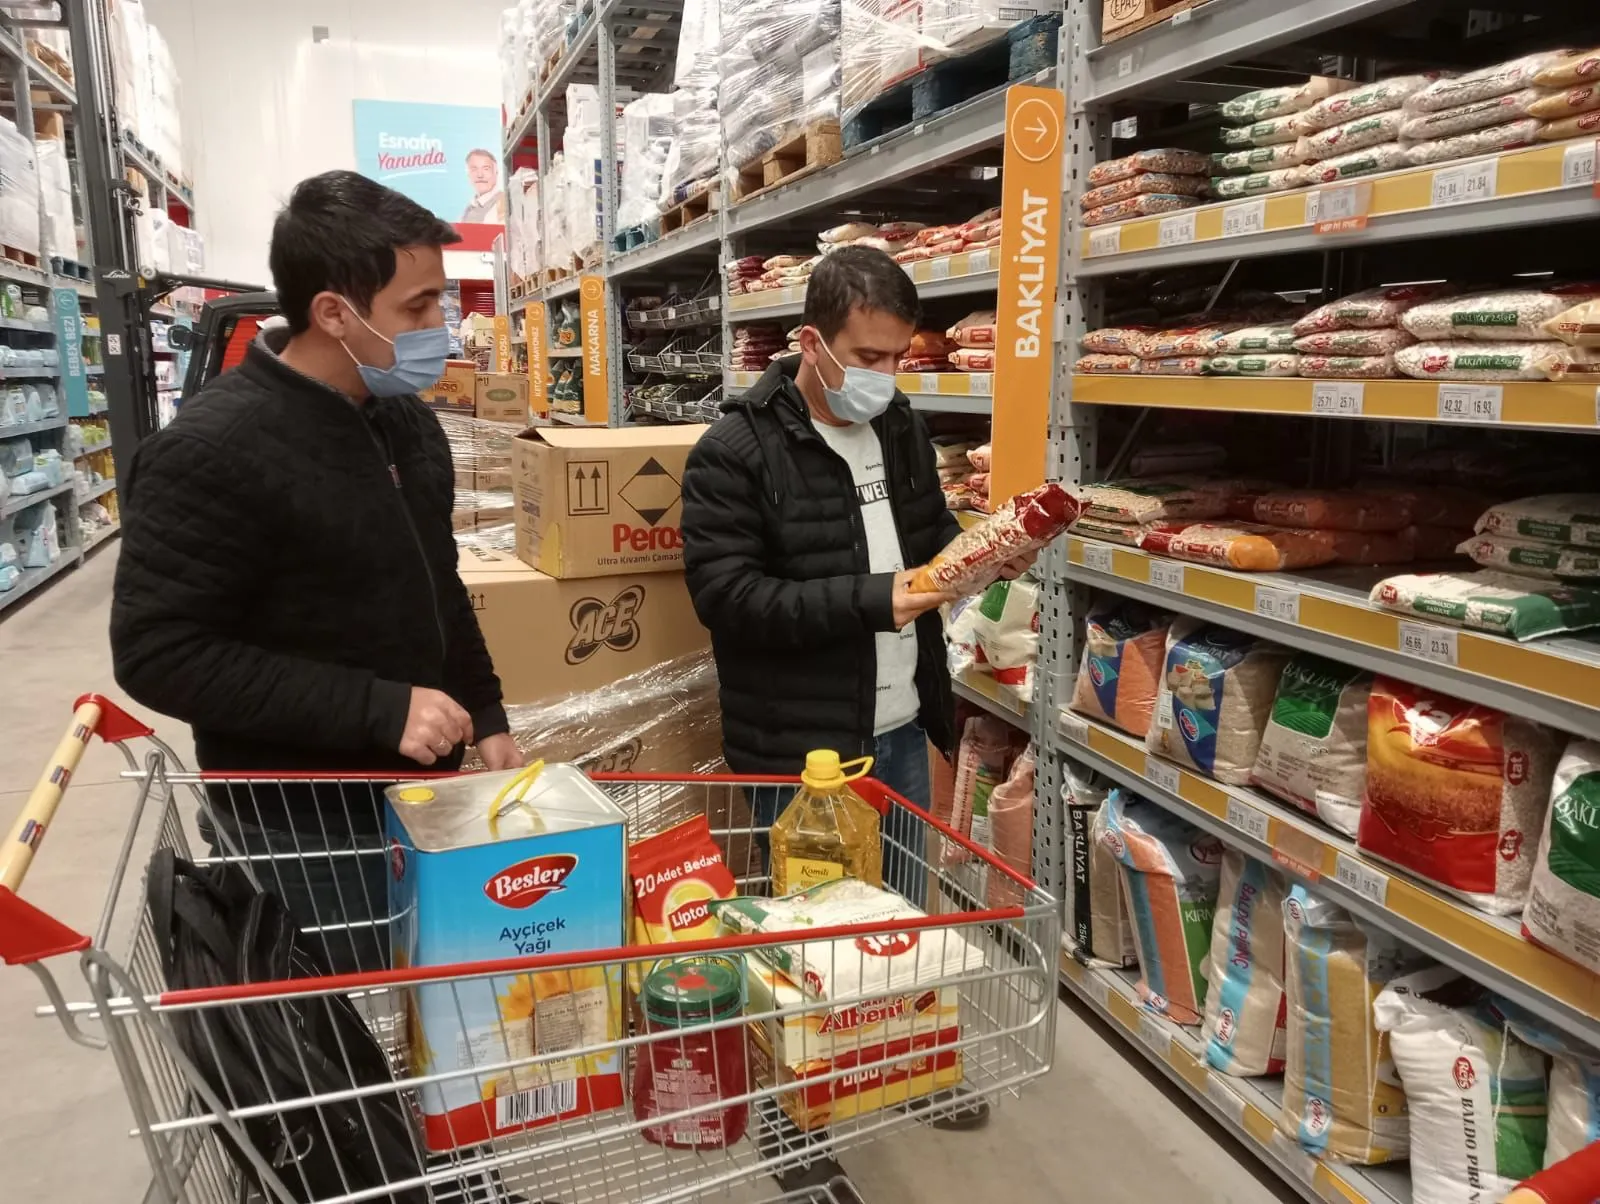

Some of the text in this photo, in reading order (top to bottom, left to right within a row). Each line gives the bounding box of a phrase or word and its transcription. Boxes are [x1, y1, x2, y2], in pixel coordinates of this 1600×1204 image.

[378, 146, 447, 171] Yanında
[1012, 188, 1049, 358] BAKLİYAT
[588, 308, 601, 376] MAKARNA
[66, 342, 81, 377] BEBEK
[597, 556, 618, 566] Ultra
[620, 555, 651, 564] Kıvamlı
[572, 599, 638, 648] ACE
[1072, 809, 1087, 885] BAKLİYAT
[494, 866, 566, 899] Besler
[635, 874, 656, 899] 20
[656, 867, 683, 885] Adet
[801, 865, 830, 878] Komili
[499, 916, 566, 942] Ayçiçek
[514, 937, 551, 955] Yağı
[817, 1002, 905, 1037] Albeni
[1461, 1097, 1479, 1151] BALDO
